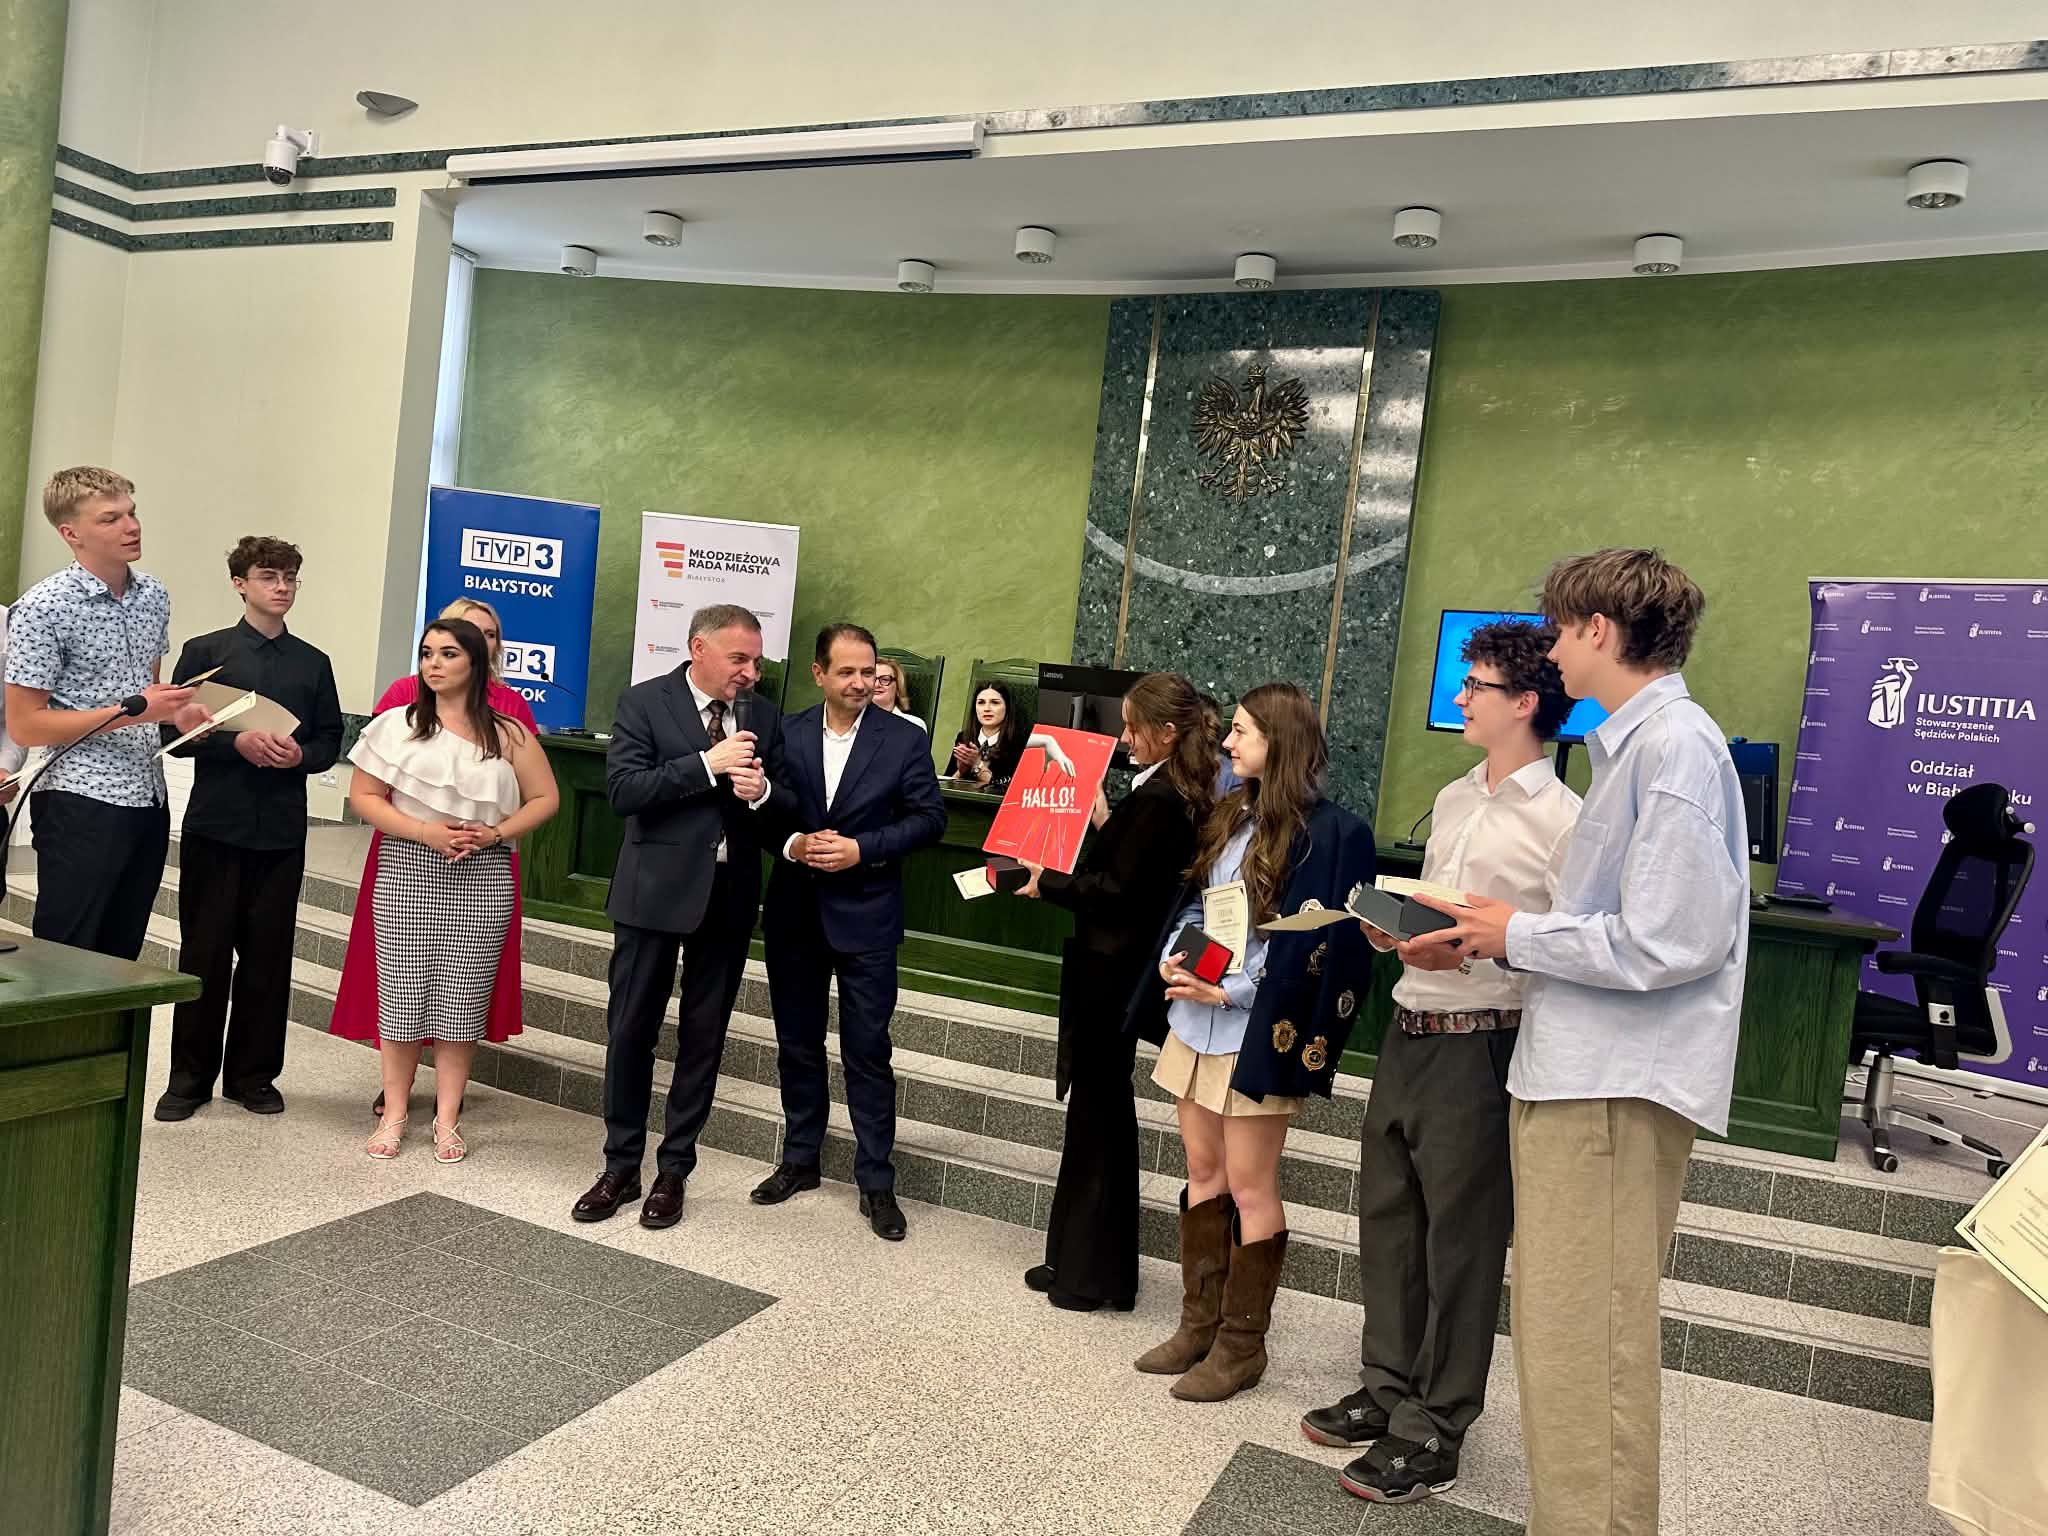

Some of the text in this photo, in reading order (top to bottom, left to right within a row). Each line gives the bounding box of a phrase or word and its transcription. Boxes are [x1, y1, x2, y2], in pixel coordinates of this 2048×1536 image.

[476, 541, 554, 570] TVP 3
[688, 548, 781, 567] MŁODZIEŻOWA
[688, 558, 770, 576] RADA MIASTA
[464, 574, 554, 598] BIAŁYSTOK
[527, 649, 546, 675] 3
[1917, 693, 2036, 721] IUSTITIA
[1915, 716, 1995, 732] Stowarzyszenie
[1914, 728, 2000, 743] Sędziów Polskich
[1910, 759, 1975, 778] Oddział
[1021, 786, 1076, 809] HALLO!
[1907, 783, 1922, 794] w
